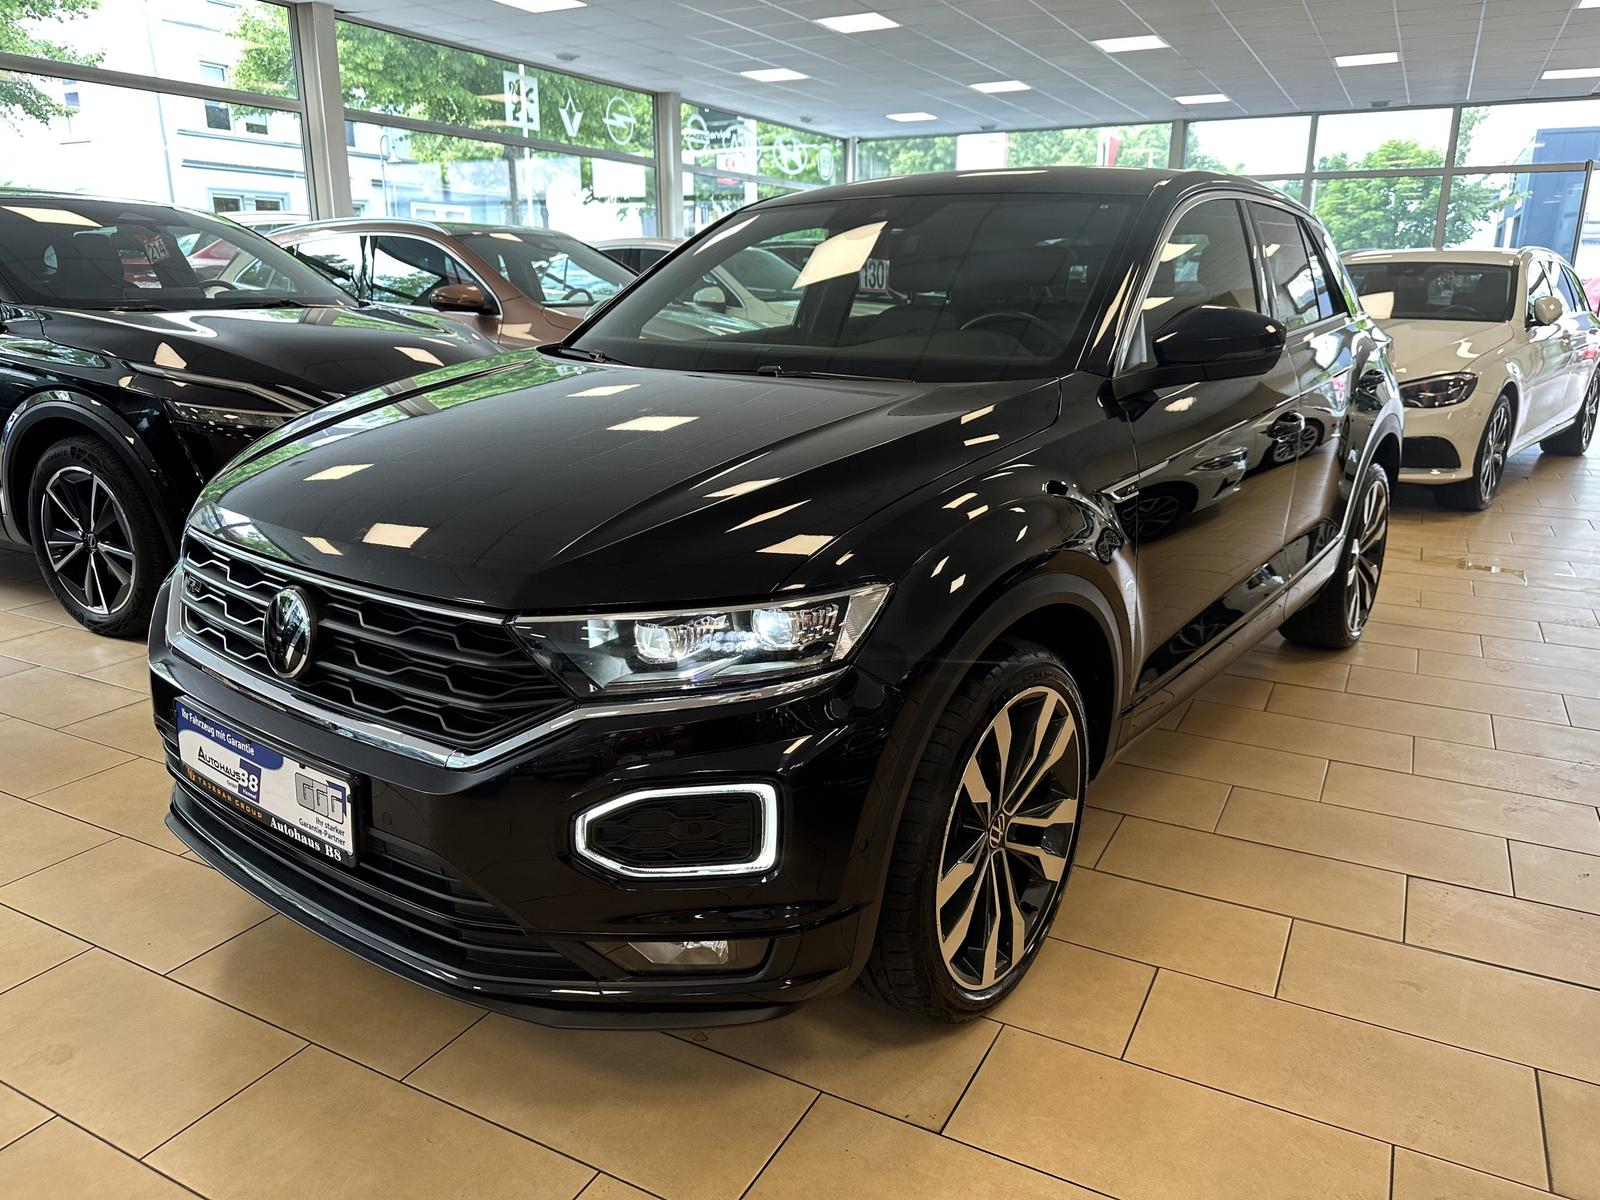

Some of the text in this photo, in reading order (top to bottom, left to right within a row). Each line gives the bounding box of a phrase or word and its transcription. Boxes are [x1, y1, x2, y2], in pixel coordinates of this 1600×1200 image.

[864, 260, 885, 289] 130
[181, 707, 255, 756] Ihr Fahrzeug mit Garantie
[234, 799, 262, 818] GROUP
[270, 817, 321, 851] Autohaus
[298, 818, 346, 847] Garantie-Partner
[324, 822, 345, 837] starker
